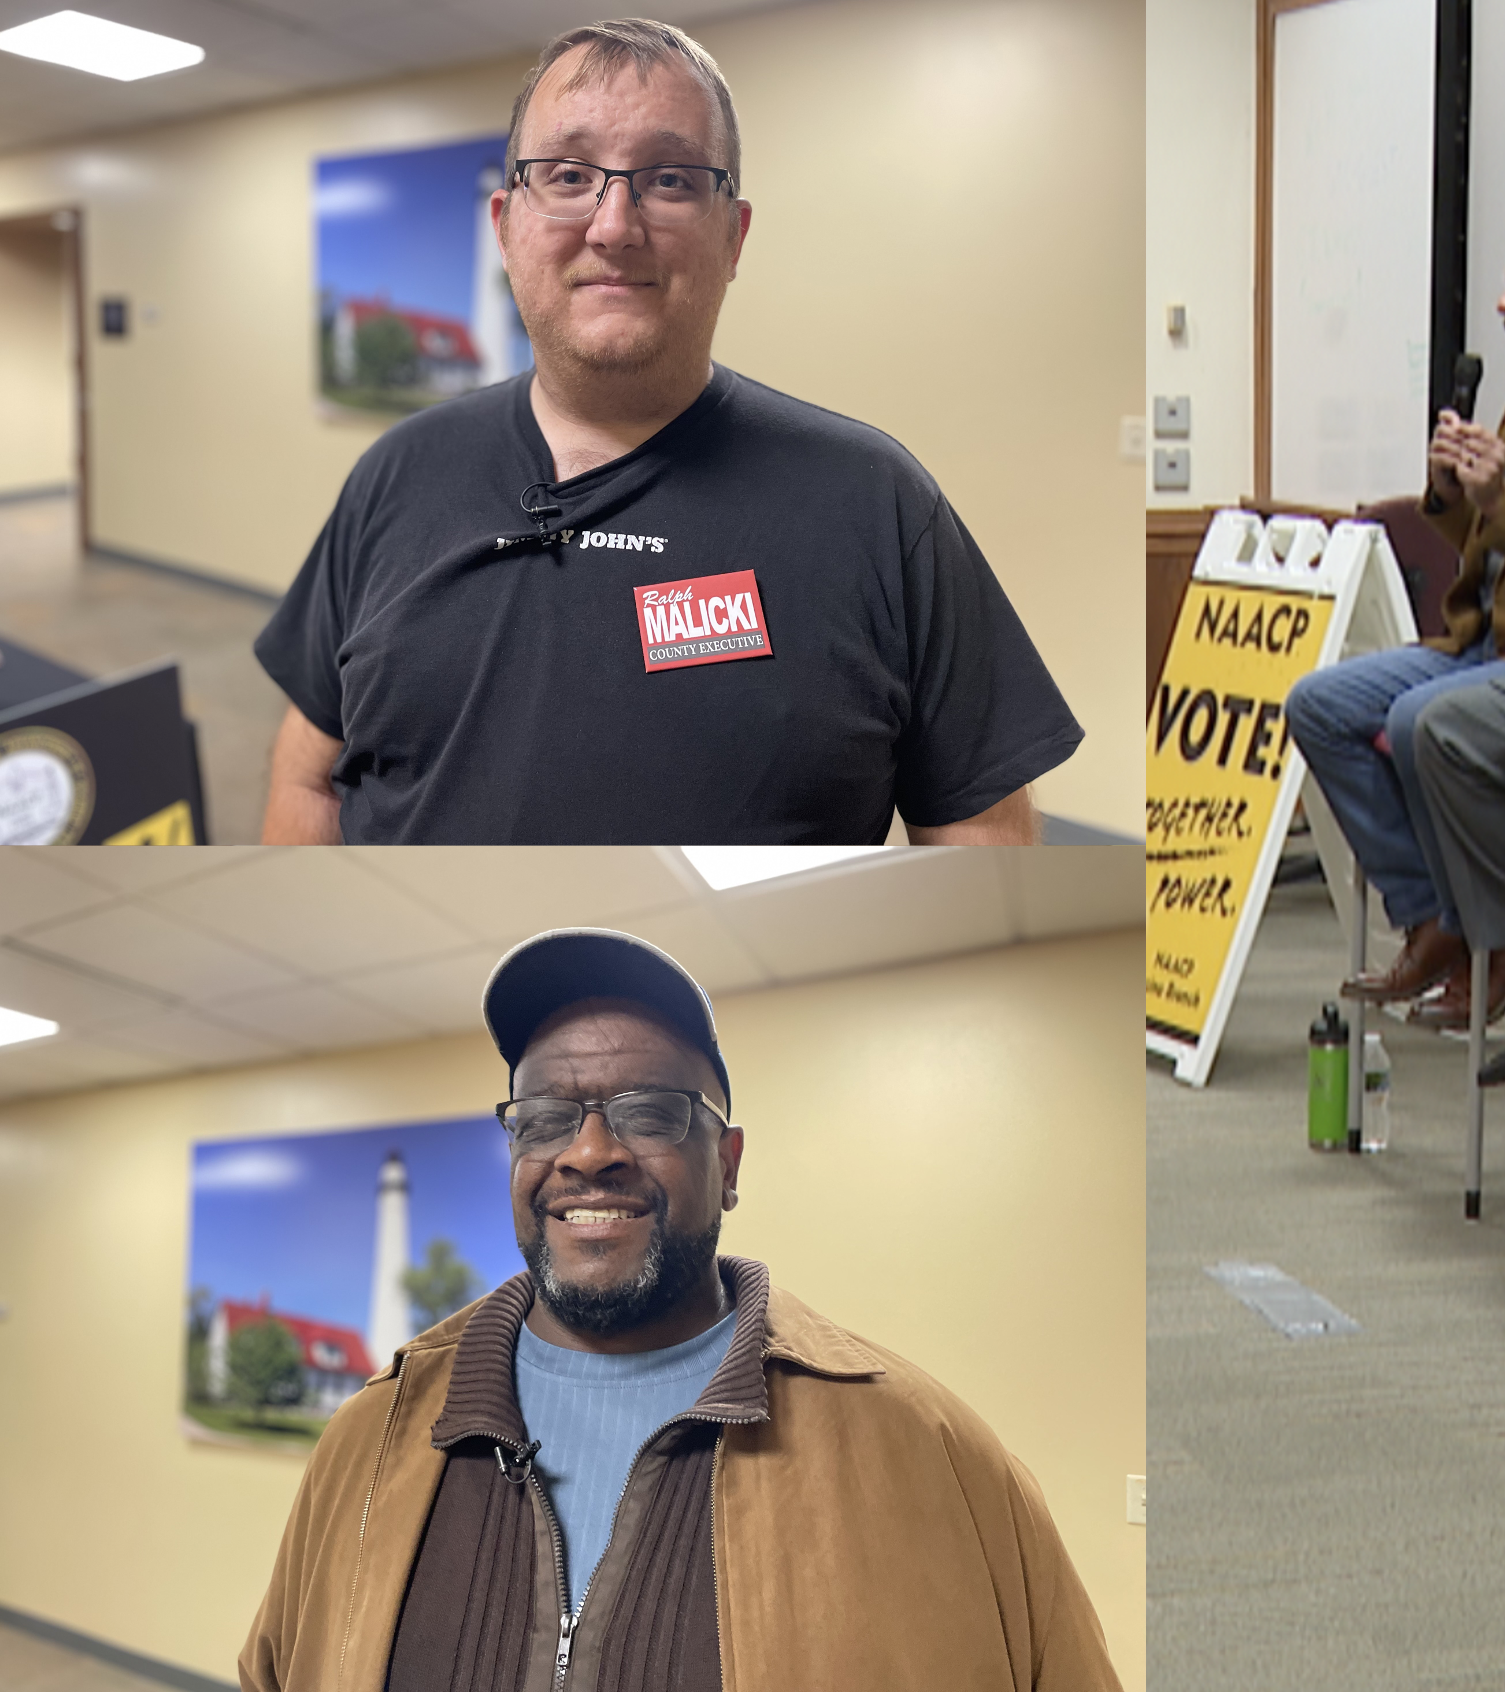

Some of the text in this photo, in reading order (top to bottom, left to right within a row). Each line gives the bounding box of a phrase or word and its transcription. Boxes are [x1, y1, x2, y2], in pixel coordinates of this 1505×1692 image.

[579, 530, 667, 553] JOHN'S
[642, 585, 694, 608] Ralph
[643, 591, 759, 644] MALICKI
[1194, 595, 1310, 656] NAACP
[649, 634, 764, 661] COUNTY EXECUTIVE
[1154, 683, 1290, 781] VOTE!
